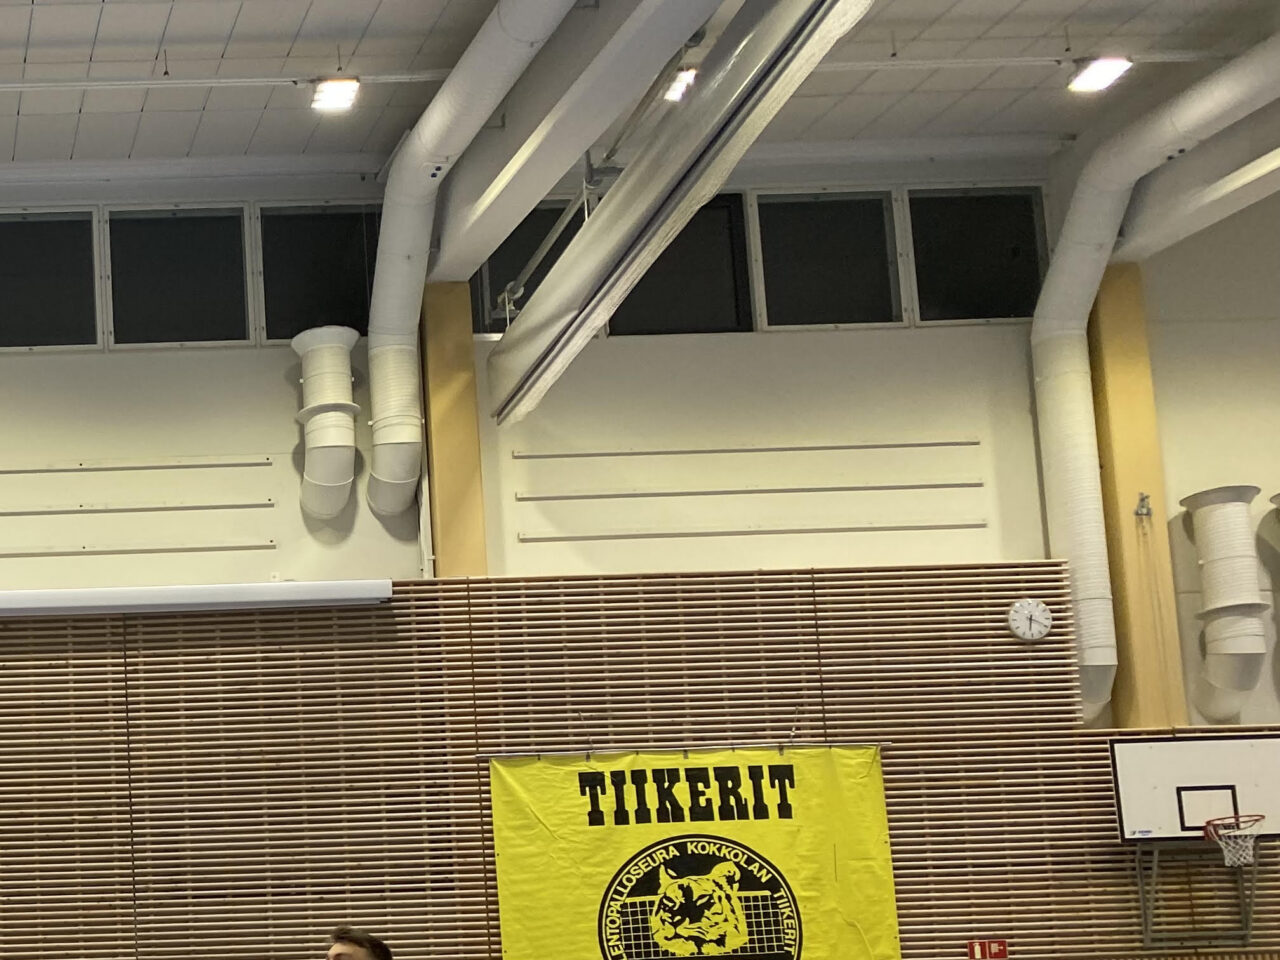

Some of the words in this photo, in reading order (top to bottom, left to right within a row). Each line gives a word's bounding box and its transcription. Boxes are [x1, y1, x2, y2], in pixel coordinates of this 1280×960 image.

[578, 764, 796, 827] TIIKERIT
[687, 841, 773, 883] KOKKOLAN
[773, 888, 797, 955] TIIKERIT
